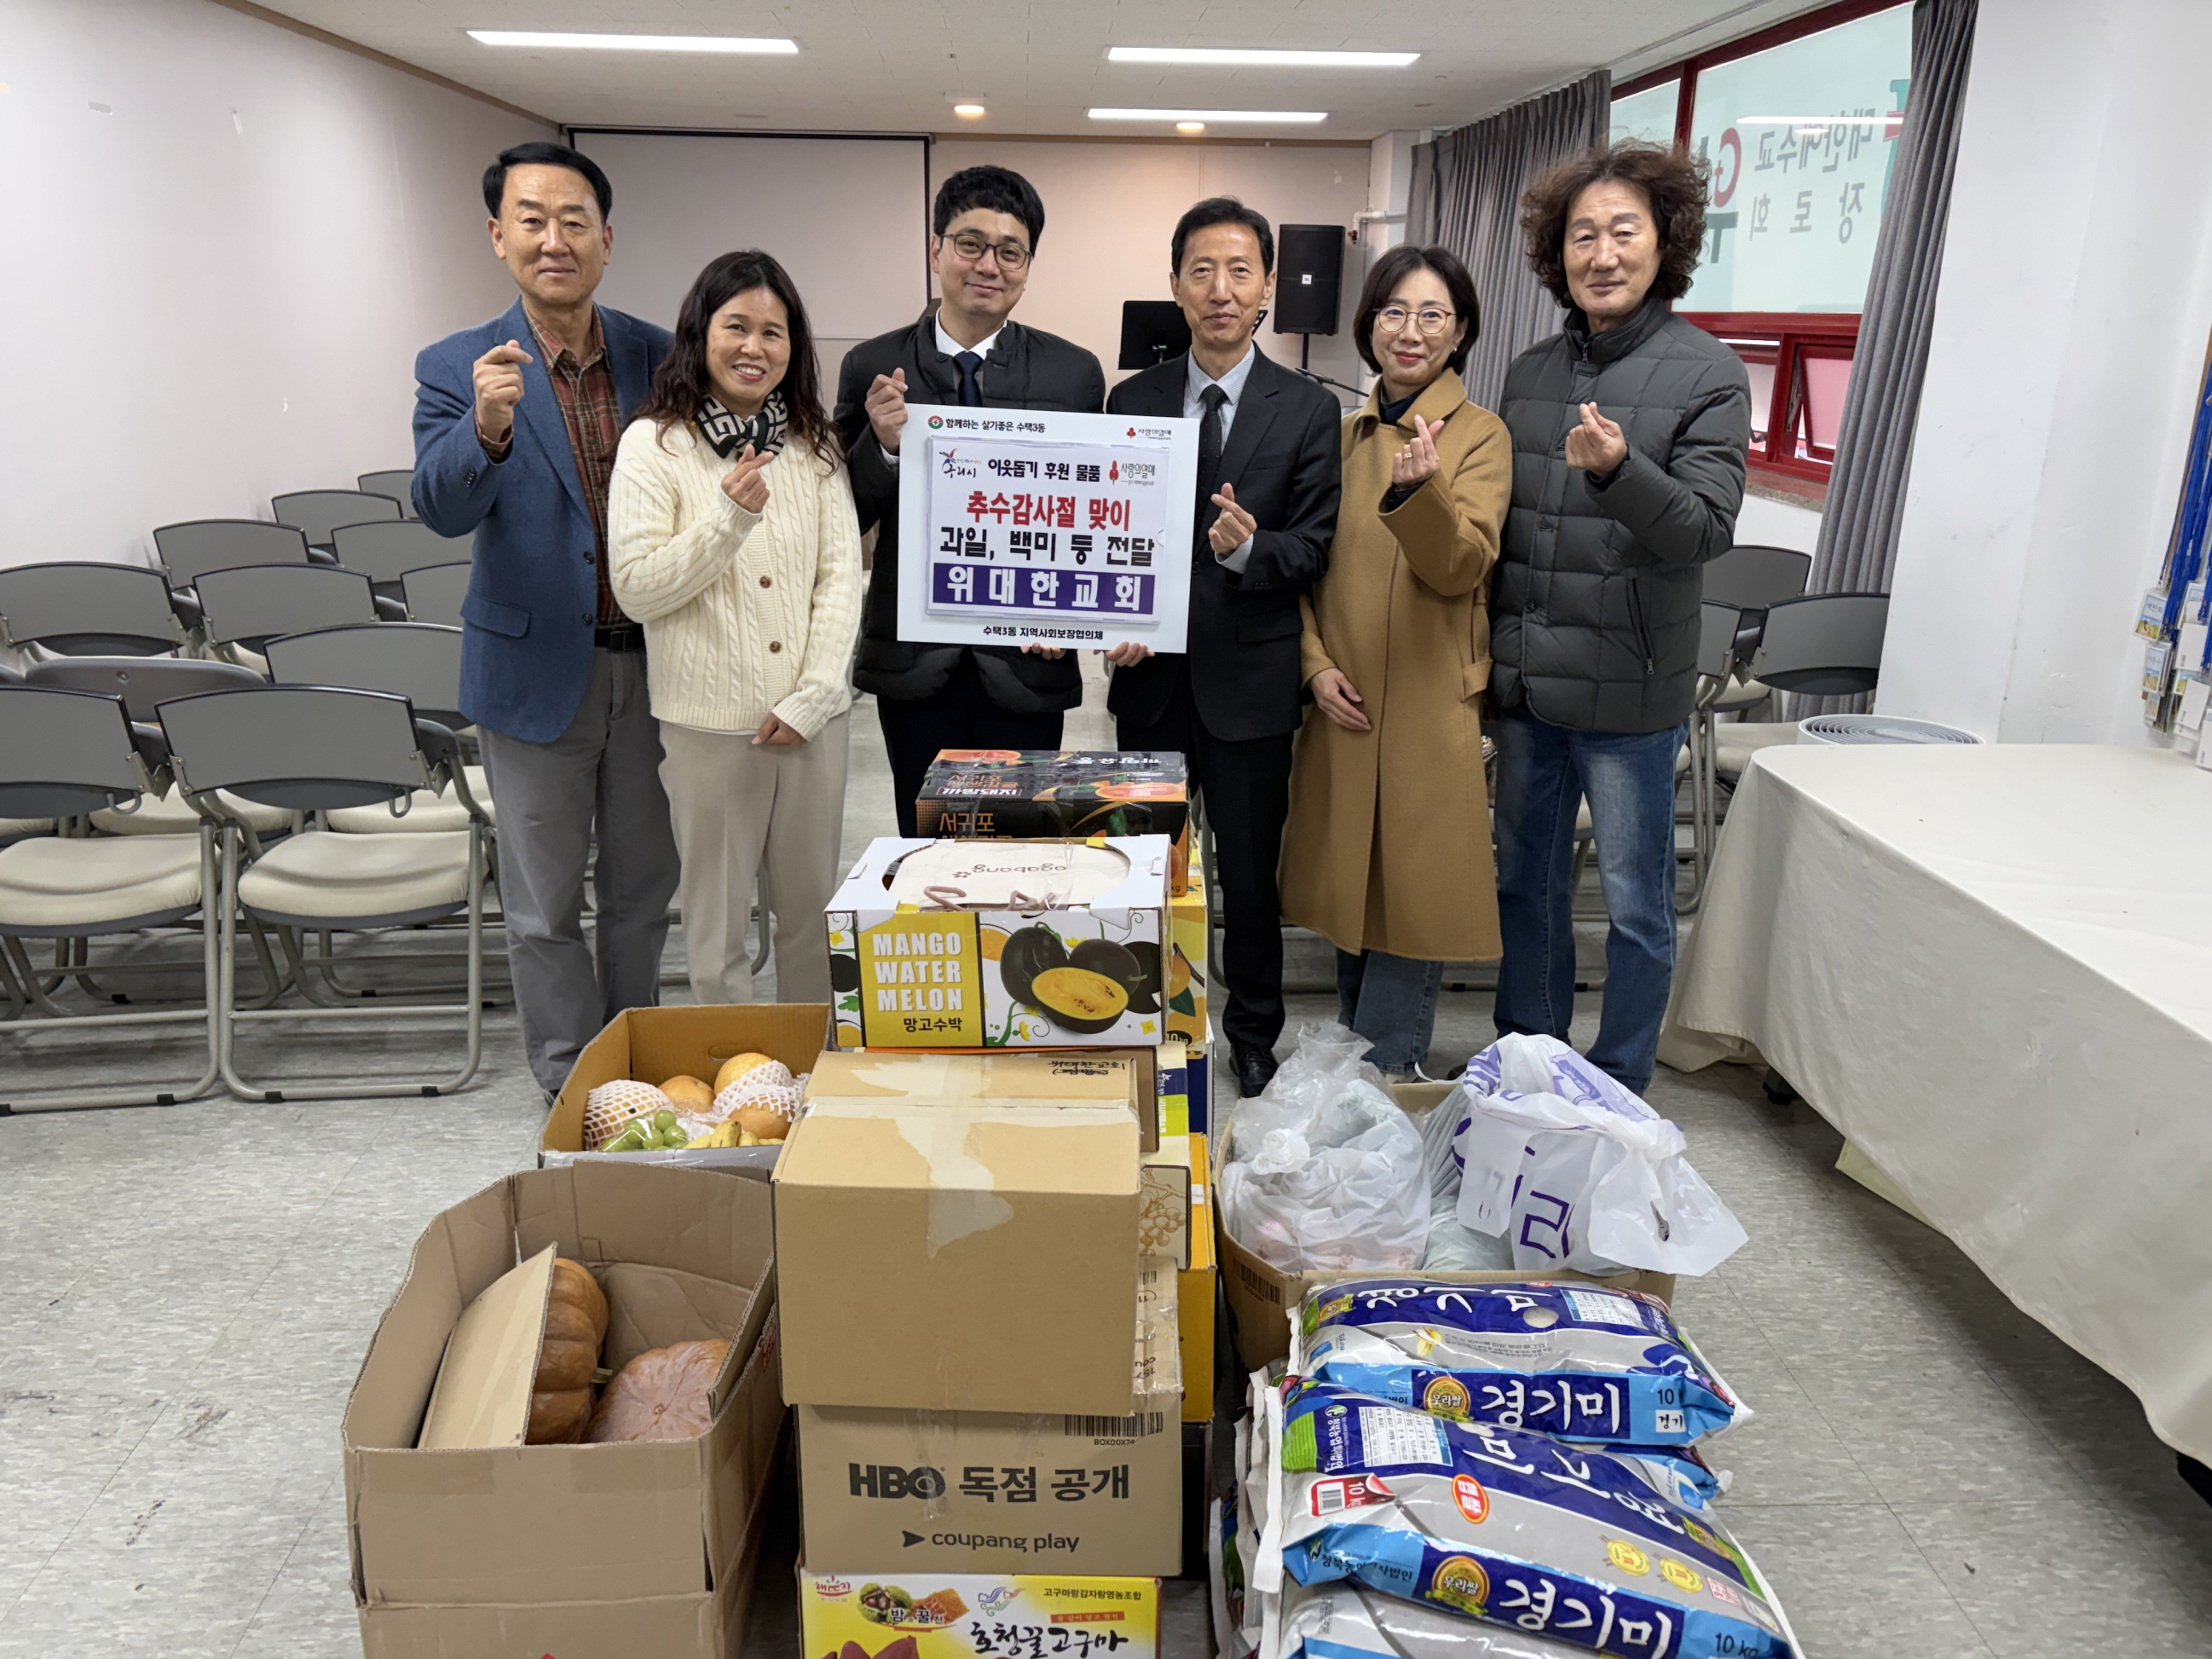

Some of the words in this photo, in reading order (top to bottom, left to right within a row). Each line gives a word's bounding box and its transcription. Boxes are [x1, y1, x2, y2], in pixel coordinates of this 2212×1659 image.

[945, 418, 979, 430] 함께하는
[981, 420, 1014, 431] 살기좋은
[1016, 422, 1046, 433] 수택3동
[944, 463, 977, 478] 구리시
[988, 459, 1038, 478] 이웃돕기
[1044, 462, 1070, 480] 후원
[1076, 464, 1100, 482] 물품
[1120, 462, 1156, 479] 사랑의열매
[967, 490, 1076, 529] 추수감사절
[1088, 497, 1130, 531] 맞이
[940, 526, 995, 561] 과일,
[1009, 530, 1057, 562] 백미
[1106, 536, 1154, 567] 전달
[983, 625, 1017, 637] 수택3동
[1019, 627, 1103, 640] 지역사회보장협의체
[939, 812, 996, 832] 서귀포
[872, 932, 962, 957] MANGO
[873, 960, 962, 984] WATER
[877, 987, 964, 1013] MELON
[903, 1016, 963, 1032] 망고수박
[1432, 1394, 1463, 1407] 우리쌀
[1481, 1379, 1620, 1434] 경기미
[1657, 1415, 1684, 1431] 경기
[848, 1462, 946, 1500] HBO
[958, 1465, 1037, 1503] 독점
[1051, 1464, 1129, 1501] 공개
[1348, 1482, 1365, 1495] 10
[931, 1532, 1027, 1552] coupang
[1034, 1532, 1080, 1552] play
[1443, 1575, 1480, 1595] 우리쌀
[1499, 1578, 1672, 1659] 경기미
[1715, 1632, 1735, 1654] 10
